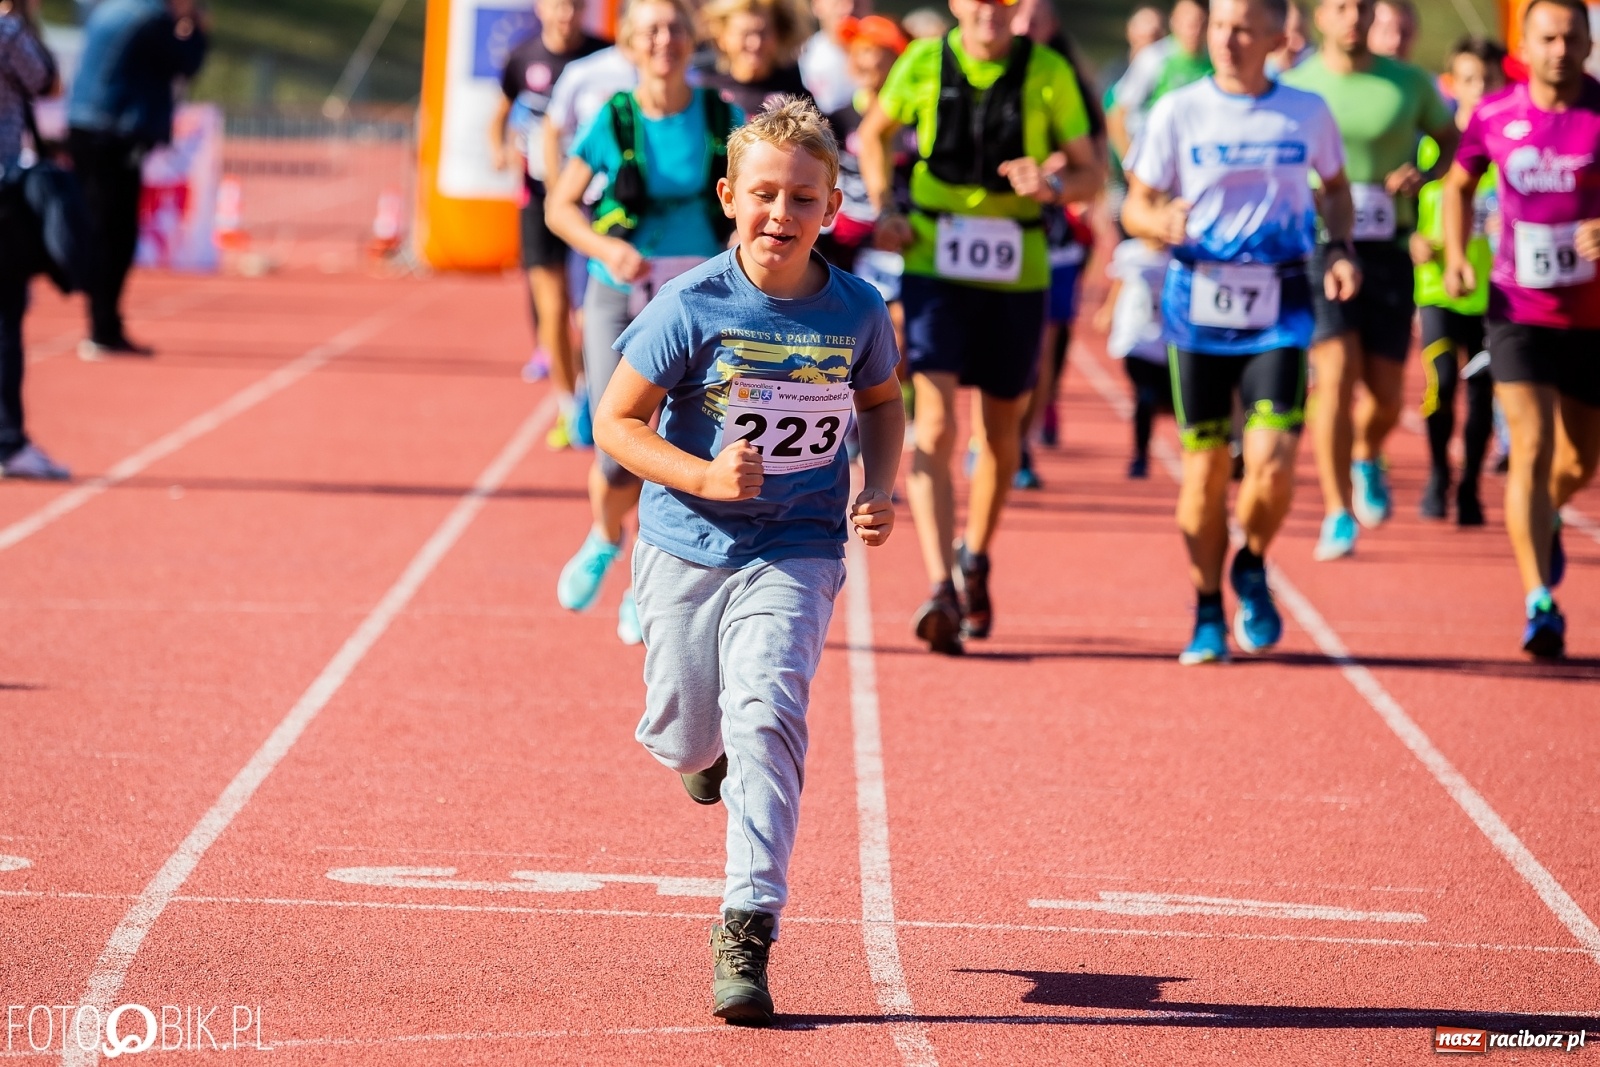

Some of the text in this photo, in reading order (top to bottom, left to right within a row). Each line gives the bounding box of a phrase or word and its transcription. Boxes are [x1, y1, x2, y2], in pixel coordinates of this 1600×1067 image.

[946, 238, 1015, 271] 109
[1534, 247, 1577, 276] 59
[1214, 285, 1260, 313] 67
[721, 327, 857, 345] SUNSETS & PALM TREES
[778, 391, 850, 402] www.personalbest.pl
[734, 412, 840, 457] 223
